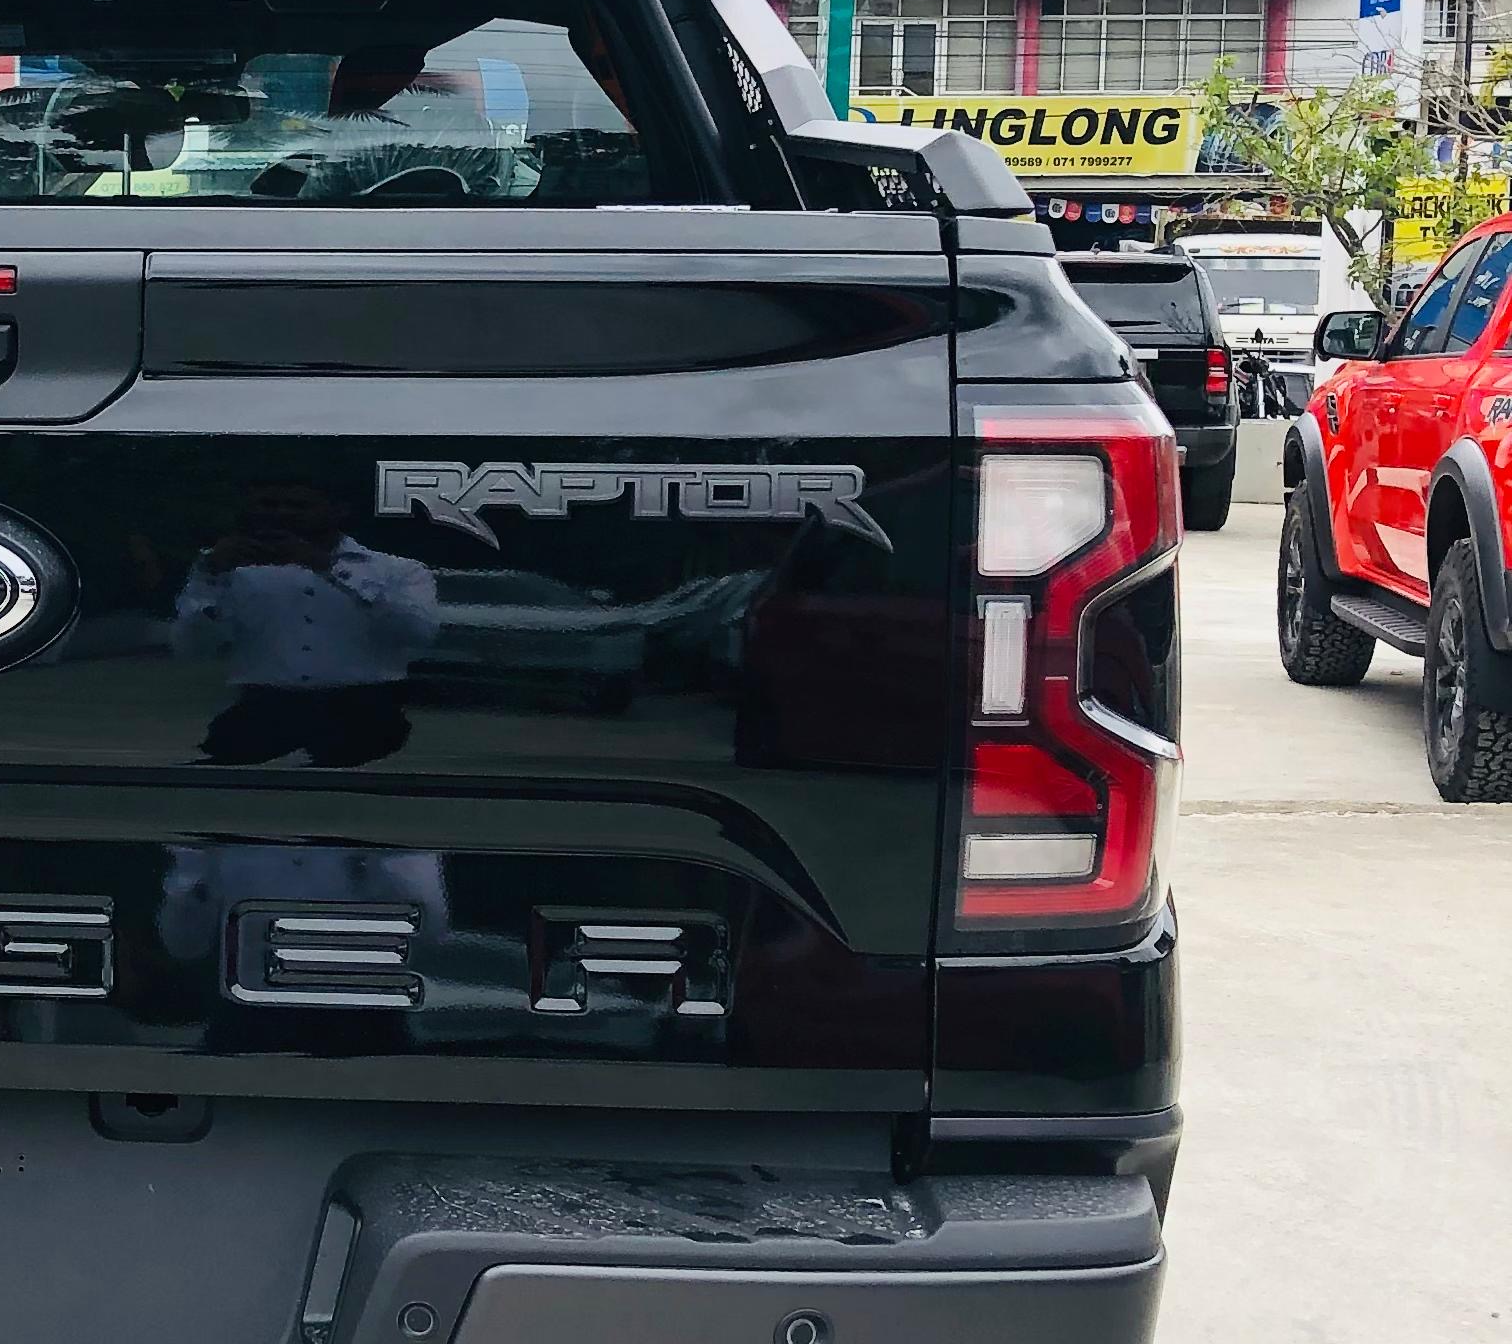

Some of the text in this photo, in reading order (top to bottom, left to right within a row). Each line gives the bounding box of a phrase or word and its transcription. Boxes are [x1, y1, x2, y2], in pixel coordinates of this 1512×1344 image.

[1053, 157, 1075, 166] 071
[1080, 157, 1133, 166] 7999277
[375, 460, 894, 554] RAPTOR
